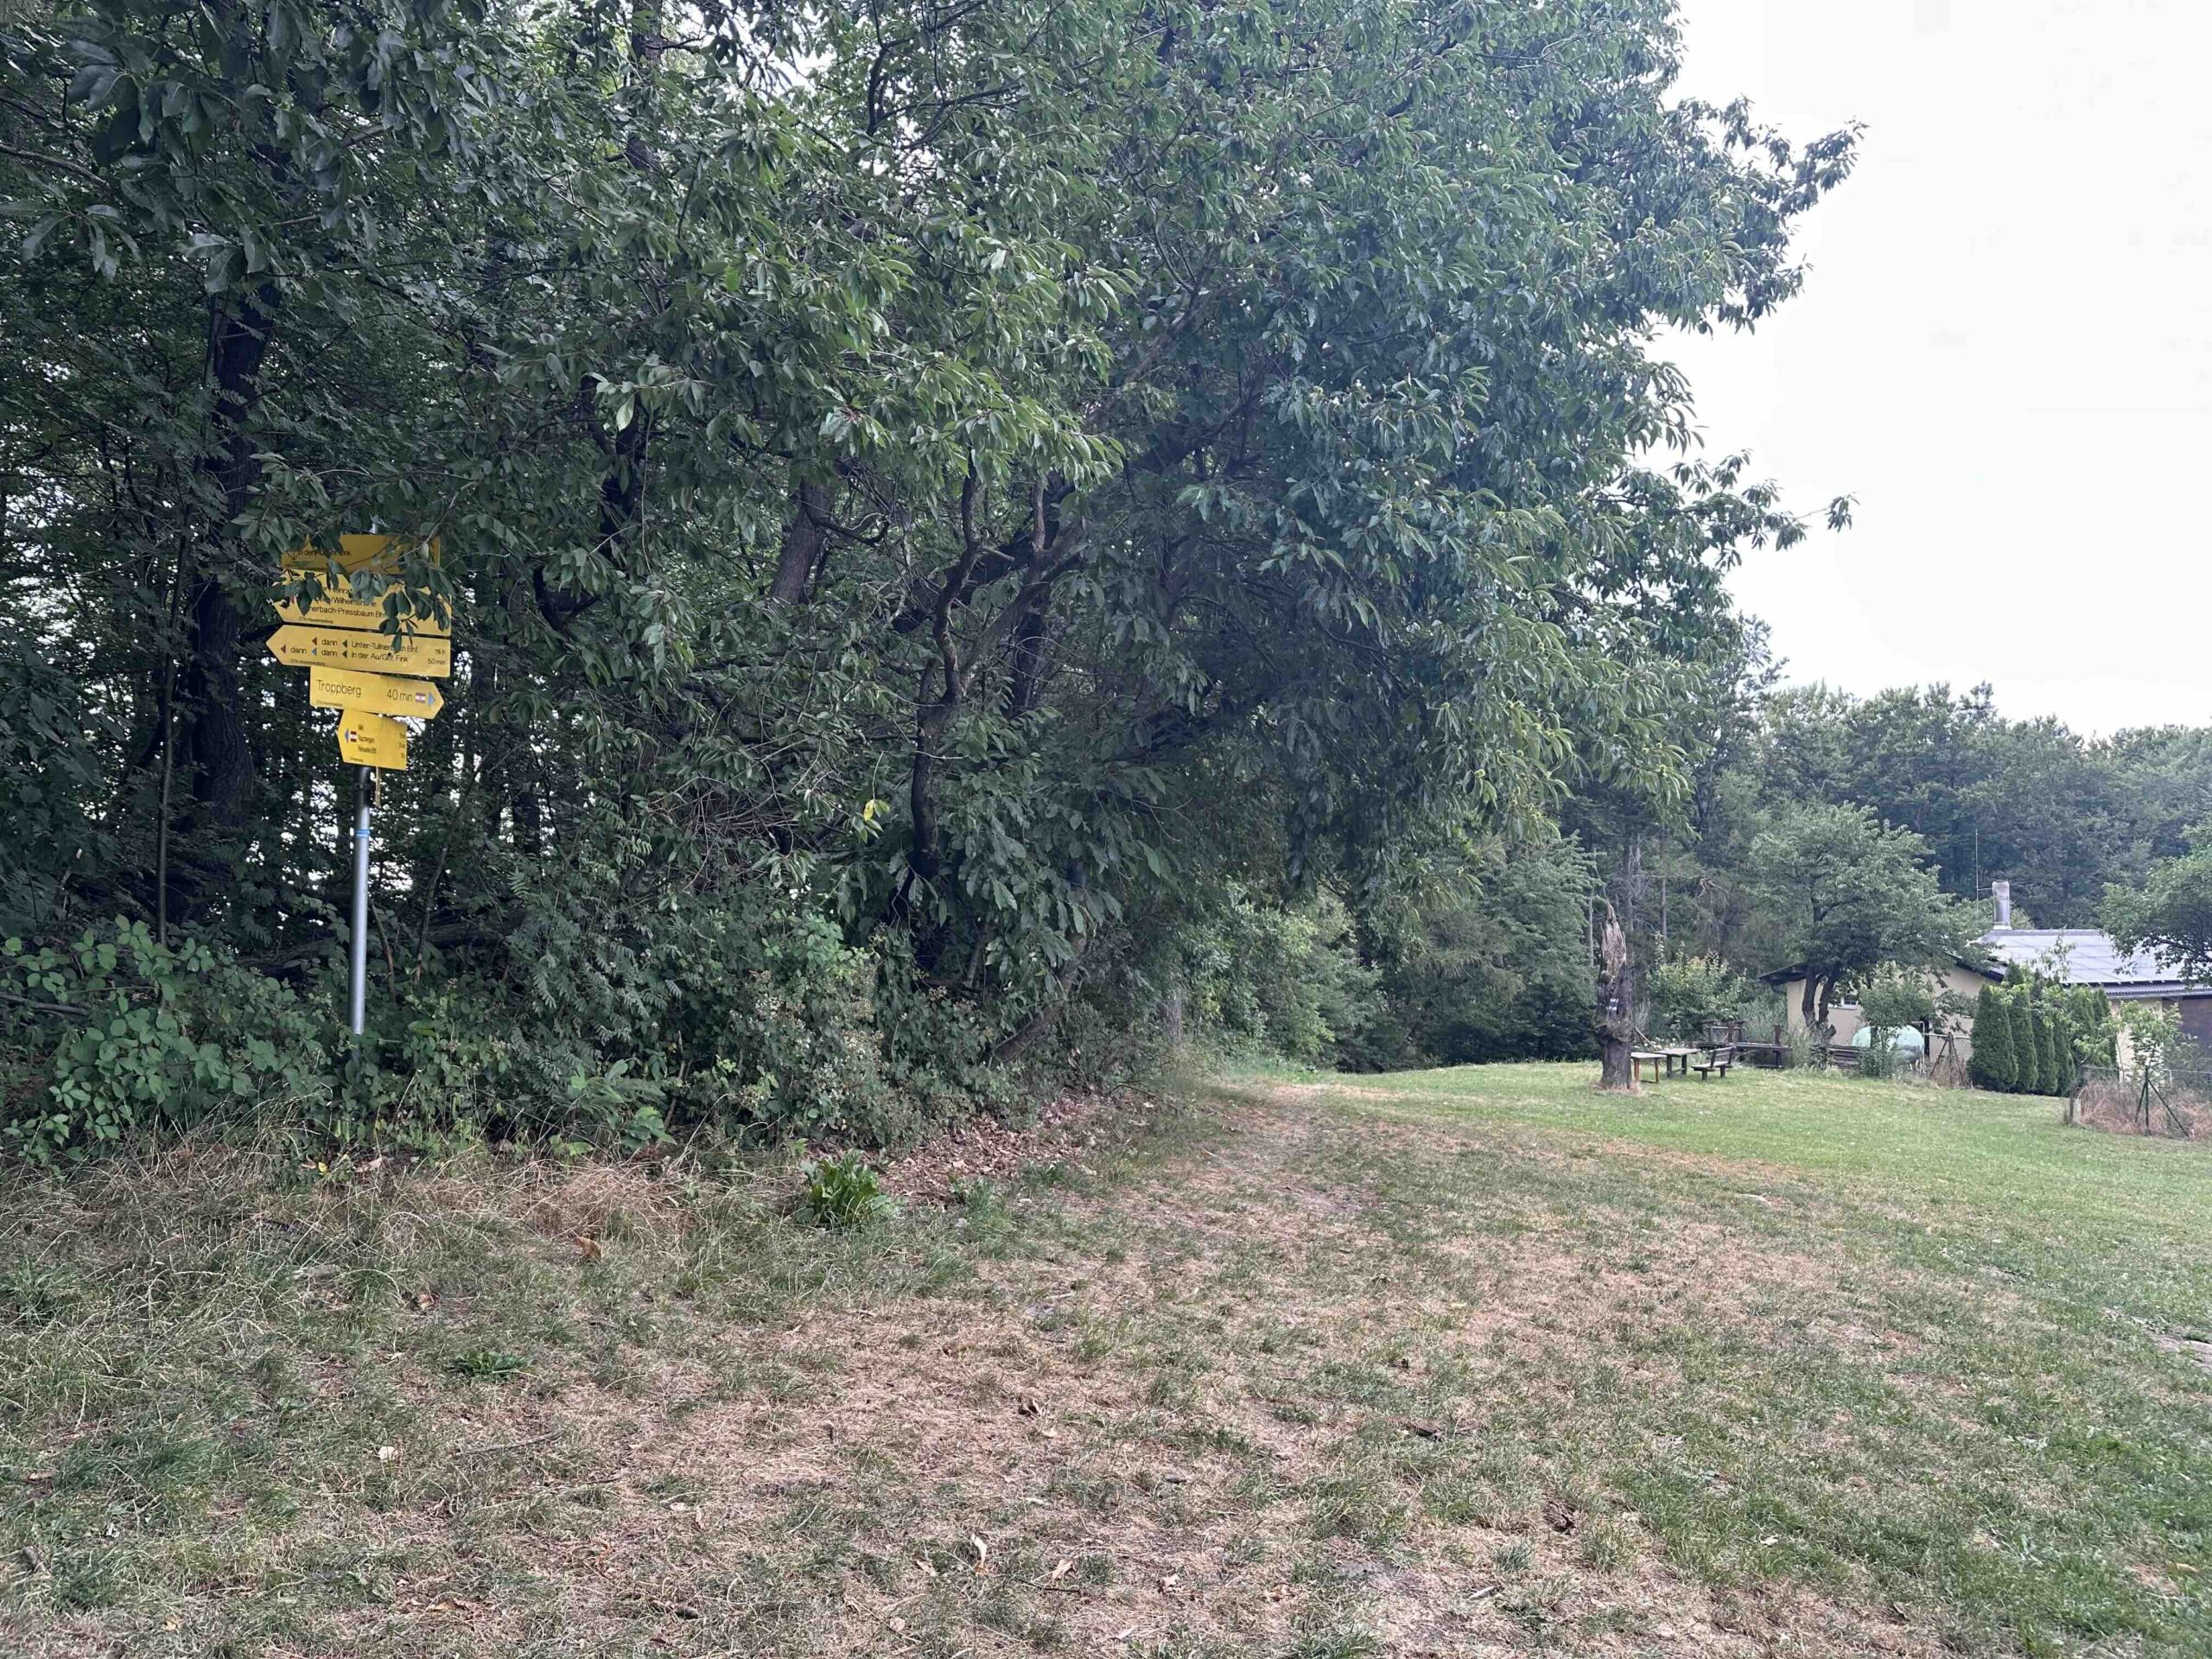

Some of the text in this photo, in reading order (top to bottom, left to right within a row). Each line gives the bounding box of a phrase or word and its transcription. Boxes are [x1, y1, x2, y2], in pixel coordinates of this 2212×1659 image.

[316, 679, 362, 698] Troppberg
[386, 688, 413, 702] 40 min
